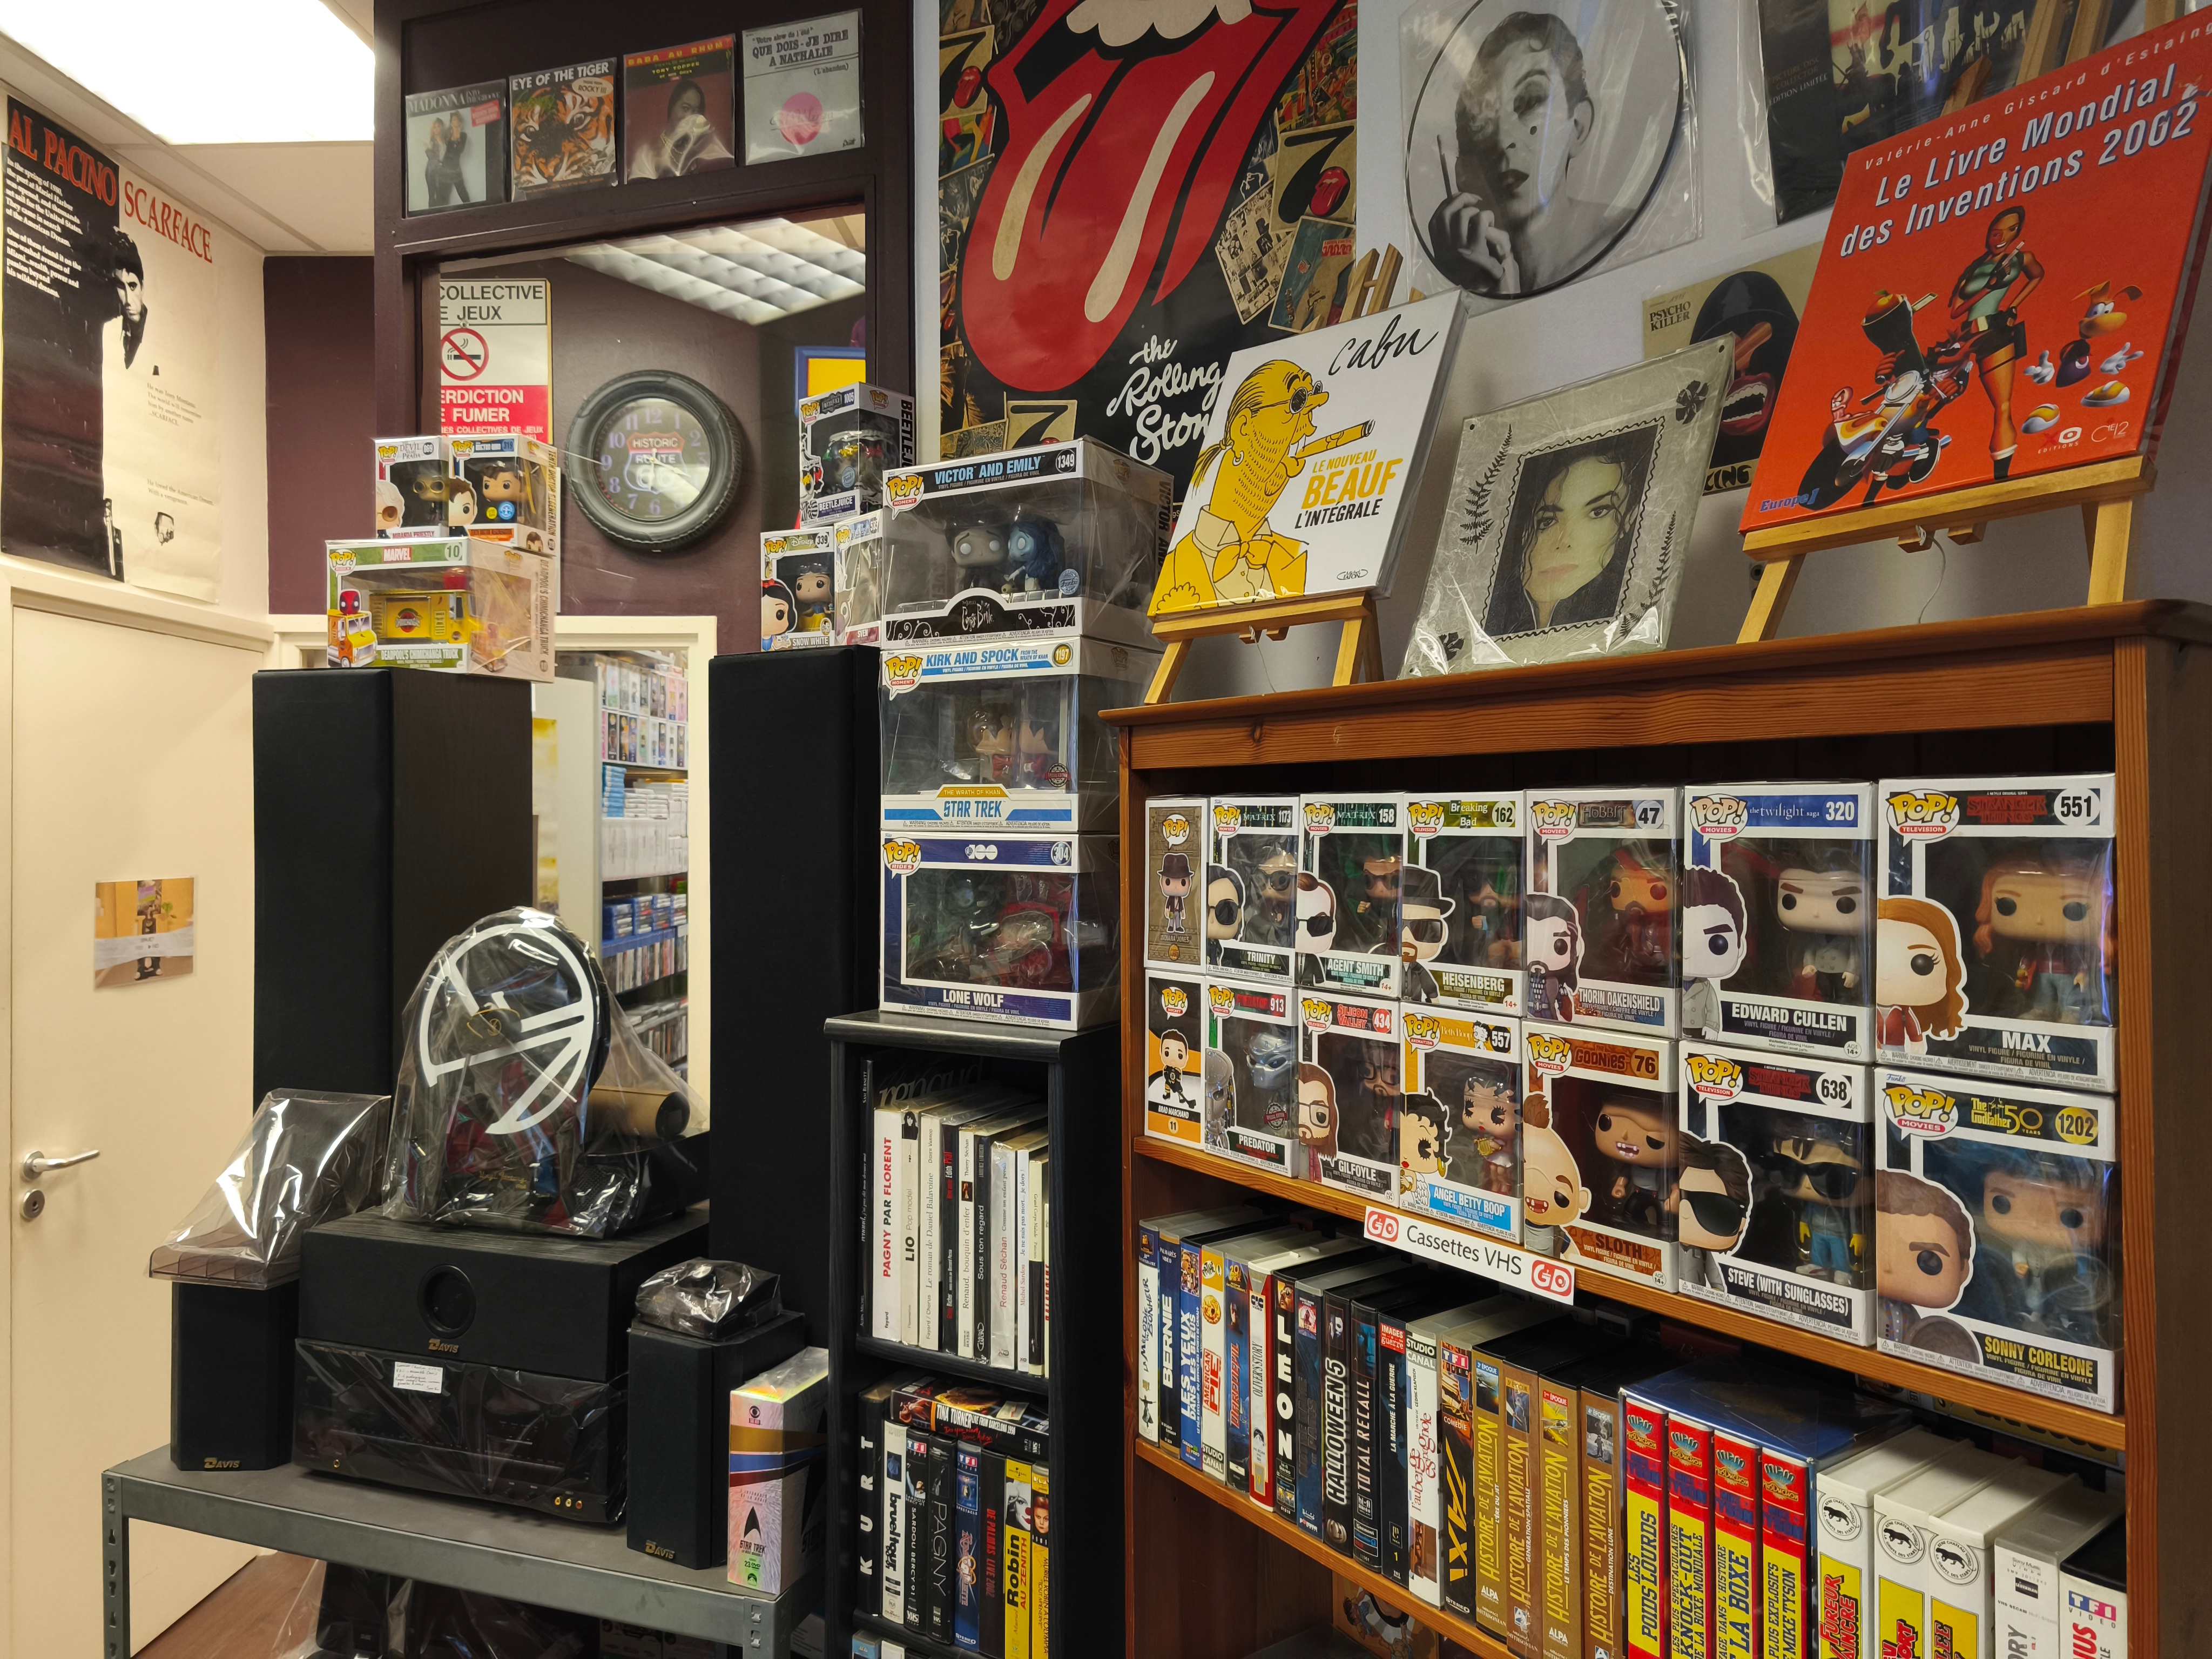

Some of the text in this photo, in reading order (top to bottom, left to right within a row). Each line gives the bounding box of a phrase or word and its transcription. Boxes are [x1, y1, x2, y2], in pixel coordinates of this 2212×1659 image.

[628, 41, 723, 66] BABA AU RHUM
[752, 45, 773, 59] QUE
[824, 30, 849, 44] DIRE
[769, 46, 833, 67] A NATHALIE
[512, 77, 532, 90] EYE
[536, 75, 550, 86] OF
[554, 70, 574, 82] THE
[577, 62, 609, 78] TIGER
[578, 86, 599, 94] ROCKY
[1865, 112, 1992, 171] Valérie-Anne
[2004, 72, 2086, 116] Giscard
[1875, 63, 2177, 208] Le Livre Mondial
[9, 110, 117, 206] AL PACINO
[1840, 217, 1893, 258] des
[1905, 149, 2083, 235] Inventions
[124, 181, 212, 264] SCARFACE
[457, 306, 502, 321] JEUX
[1649, 301, 1691, 322] PSYCHO
[1650, 310, 1690, 332] KILLER
[1129, 334, 1178, 364] the
[1328, 313, 1440, 376] cabu
[441, 389, 524, 404] ERDICTION
[1107, 361, 1225, 417] Rolling
[453, 408, 510, 422] FUMER
[457, 426, 509, 434] COLLECTIVES
[632, 437, 678, 448] HISTORIC
[1130, 404, 1210, 466] Ston
[636, 454, 676, 463] ROUTE
[2038, 441, 2079, 454] EDITIONS
[935, 455, 1075, 485] VICTOR AND EMILY 1349
[1312, 449, 1377, 473] LE NOUVEAU
[1301, 458, 1404, 510] BEAUF
[819, 497, 853, 511] BEETLEJUICE
[1294, 498, 1382, 529] L'INTÉGRALE
[383, 545, 460, 561] MARVEL 10
[793, 636, 828, 646] SNOW WHITE
[926, 648, 1019, 667] KIRK AND SPOCK
[1055, 649, 1070, 661] 1197
[943, 800, 1002, 818] STAR TREK
[1451, 802, 1513, 823] Breaking 162
[1638, 807, 1660, 824] 47
[1690, 797, 1748, 826] POP!
[1750, 806, 1759, 814] the
[1760, 804, 1804, 819] twilight
[1826, 802, 1854, 821] 320
[1887, 791, 2092, 825] POP! 551
[1460, 815, 1476, 827] Bad
[1247, 950, 1276, 963] TRINITY
[1327, 959, 1384, 976] AGENT SMITH
[1442, 973, 1505, 992] HEISENBERG
[943, 989, 1004, 1007] LONE WOLF
[1579, 987, 1660, 1011] THORIN OAKENSHIELD
[1337, 1004, 1391, 1028] SILICON 434
[1338, 1014, 1367, 1028] VALLEY
[1732, 1003, 1847, 1031] EDWARD CULLEN
[2002, 1031, 2052, 1053] MAX
[1635, 1054, 1656, 1074] 76
[1821, 1078, 1847, 1101] 638
[1158, 1105, 1189, 1119] BRAD MARCHAND
[2058, 1112, 2094, 1138] 1202
[1239, 1134, 1276, 1155] PREDATOR
[1338, 1160, 1377, 1181] GILFOYLE
[926, 1172, 934, 1210] Balavoine
[1433, 1185, 1506, 1216] ANGEL BETTY BOOP
[883, 1137, 892, 1278] PAGNY PAR FLORENT
[905, 1236, 915, 1262] LIO
[927, 1240, 933, 1249] de
[1407, 1225, 1521, 1275] Cassettes VHS
[1595, 1233, 1642, 1260] SLOTH
[926, 1278, 933, 1288] Le
[1728, 1268, 1849, 1317] STEVE (WITH SUNGLASSES)
[428, 1339, 458, 1353] DAVIS
[1162, 1293, 1172, 1389] BERNIE
[1406, 1340, 1435, 1356] STUDIO
[1181, 1311, 1191, 1418] LES YEUX
[1406, 1351, 1435, 1369] CANAL
[1985, 1336, 2094, 1378] SONNY CORLEONE
[1210, 1354, 1219, 1413] PIE
[1230, 1343, 1240, 1429] DAREDEVIL
[936, 1404, 972, 1429] TINA TURNER
[1326, 1357, 1346, 1505] HALLOWEEN 5
[1357, 1380, 1371, 1493] TOTAL RECALL
[1478, 1417, 1500, 1582] HISTOIRE DE L'AVIATION
[645, 1540, 676, 1559] DAVIS
[740, 1540, 765, 1554] STAR TREK
[1007, 1534, 1020, 1608] Robin
[1628, 1552, 1640, 1585] LES
[1641, 1510, 1657, 1642] POIDS LOURDS
[1678, 1527, 1694, 1659] KNOCK-OUT
[1729, 1549, 1750, 1654] LA BOXE
[1782, 1568, 1796, 1656] MIKE TYSON
[1819, 1574, 1844, 1645] FUREUR
